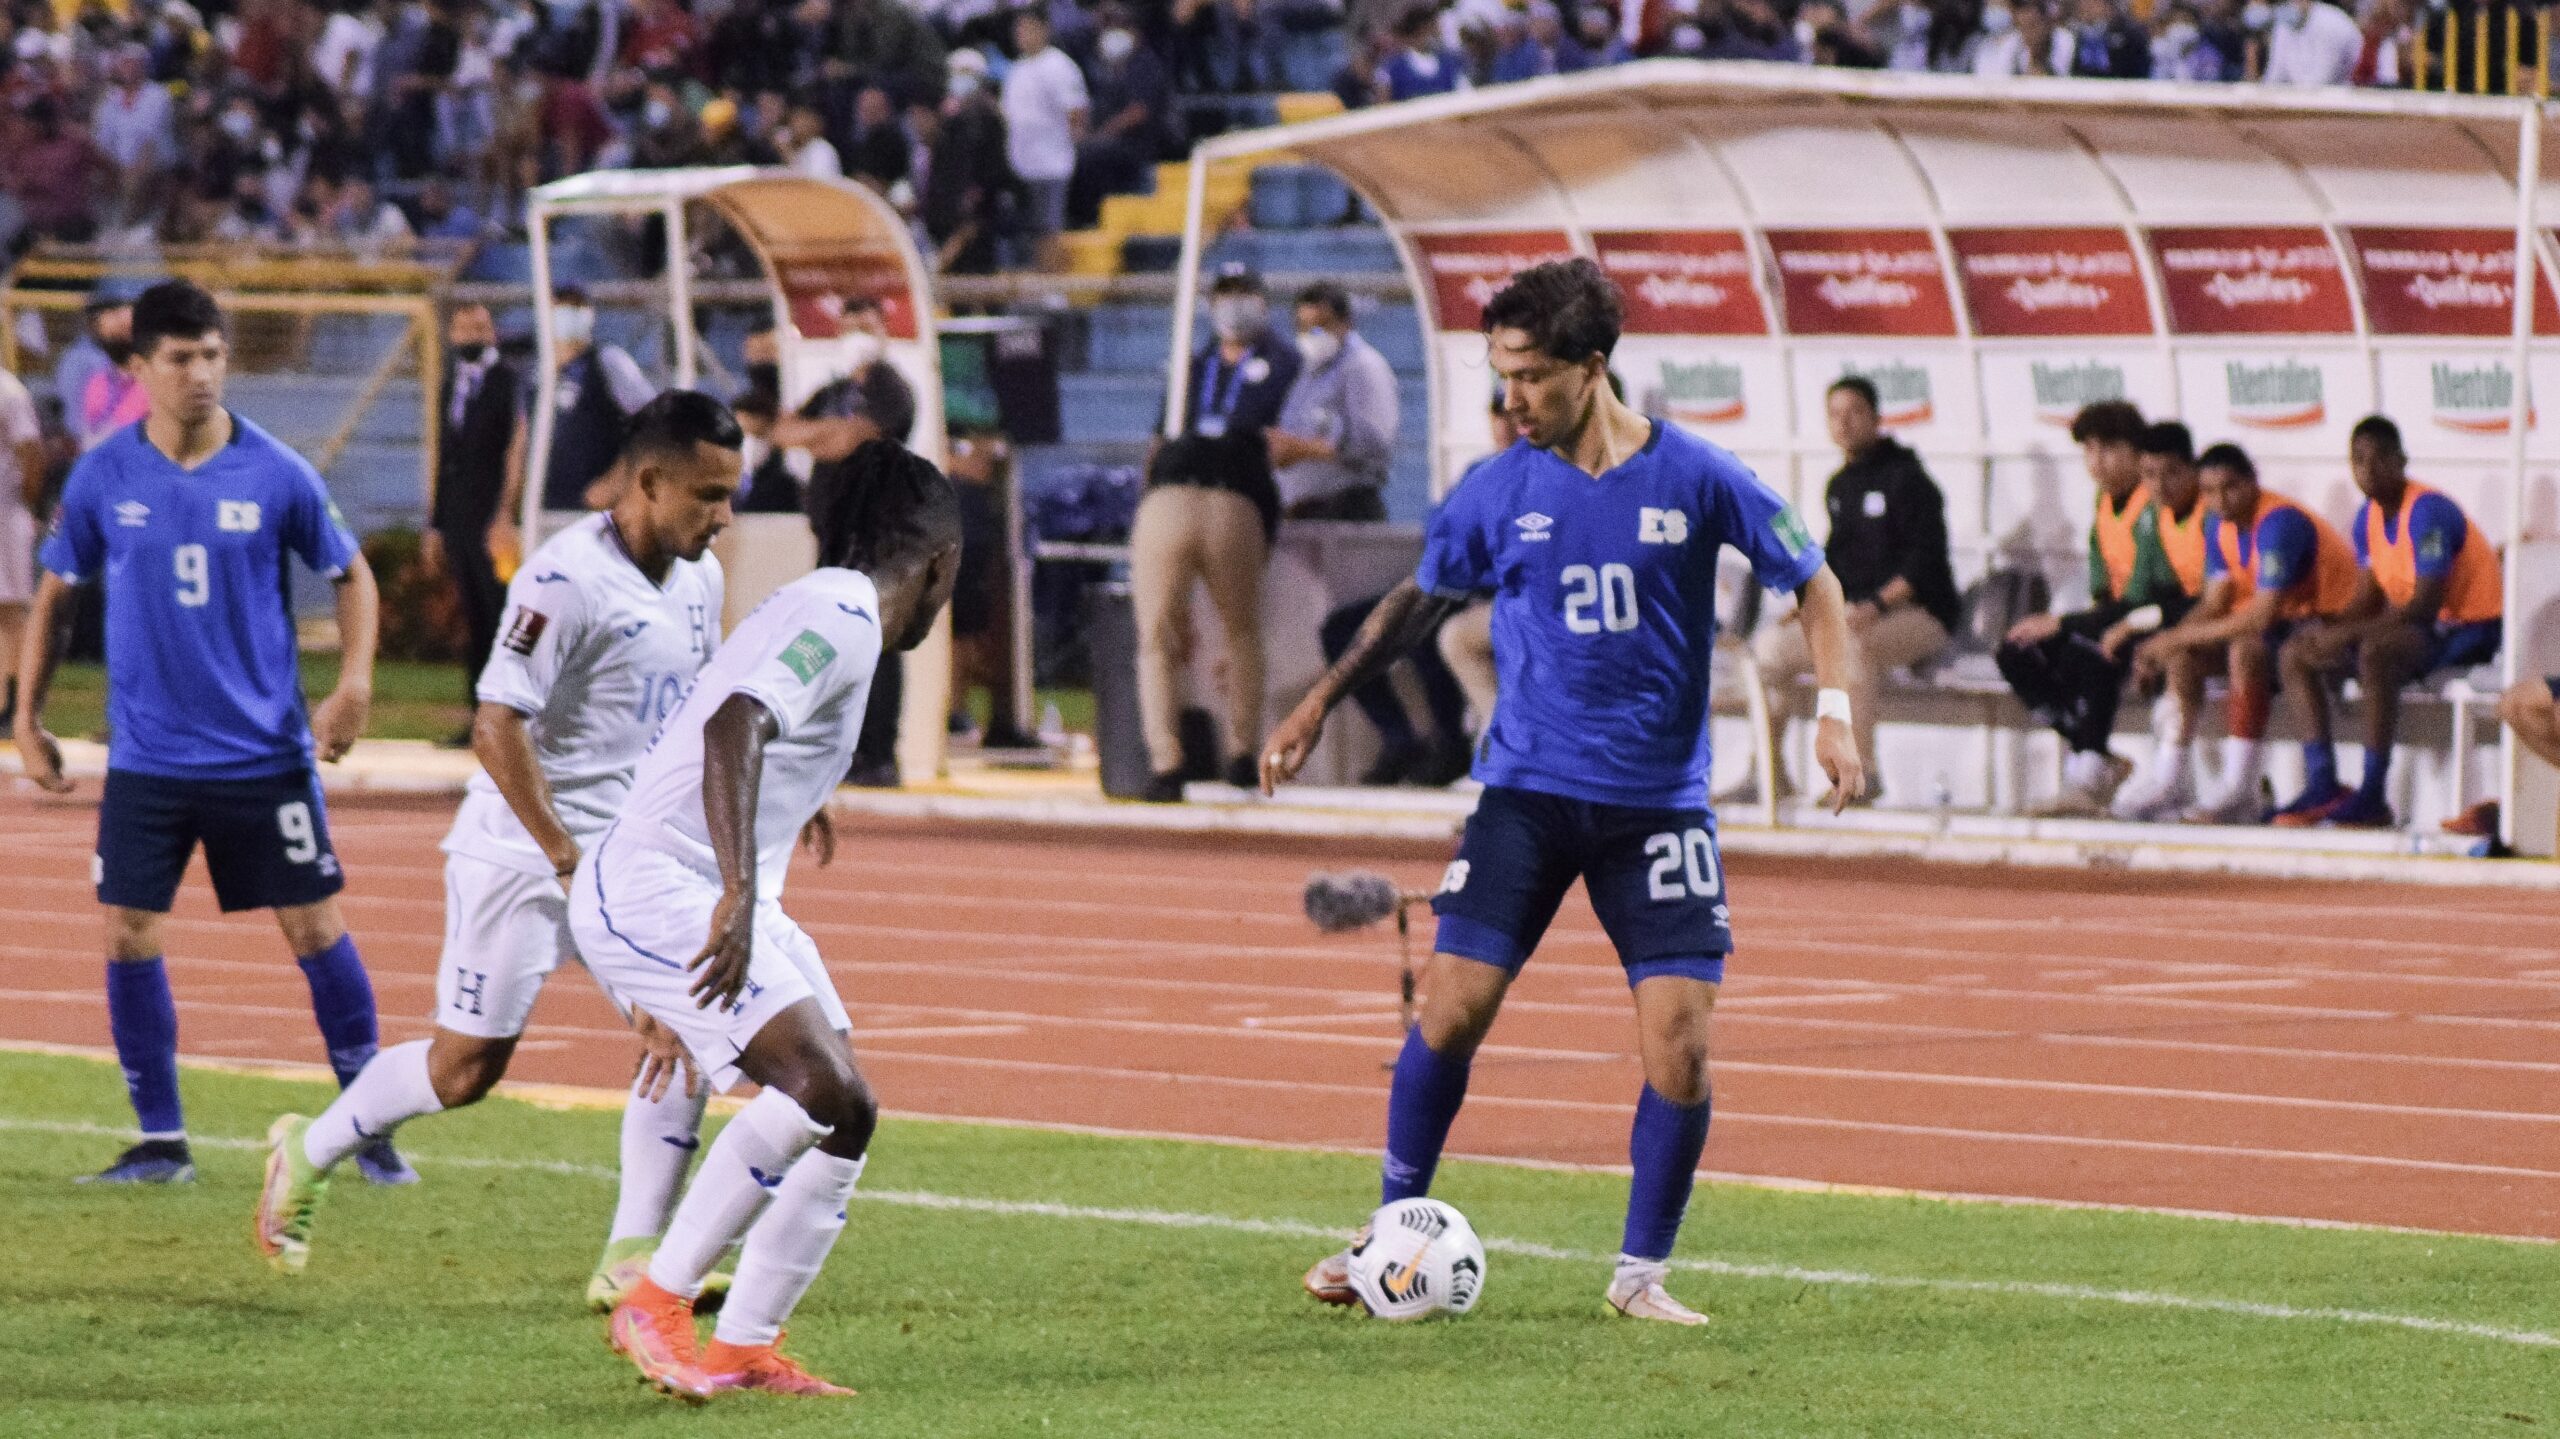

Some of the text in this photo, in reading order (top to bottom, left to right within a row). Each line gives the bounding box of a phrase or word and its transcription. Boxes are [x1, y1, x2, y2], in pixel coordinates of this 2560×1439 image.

[2226, 356, 2323, 405] Mentolina
[1637, 506, 1688, 544] ES
[175, 544, 209, 607] 9
[1560, 562, 1639, 634] 20
[277, 801, 318, 864] 9
[1645, 828, 1720, 900] 20
[454, 967, 489, 1017] H
